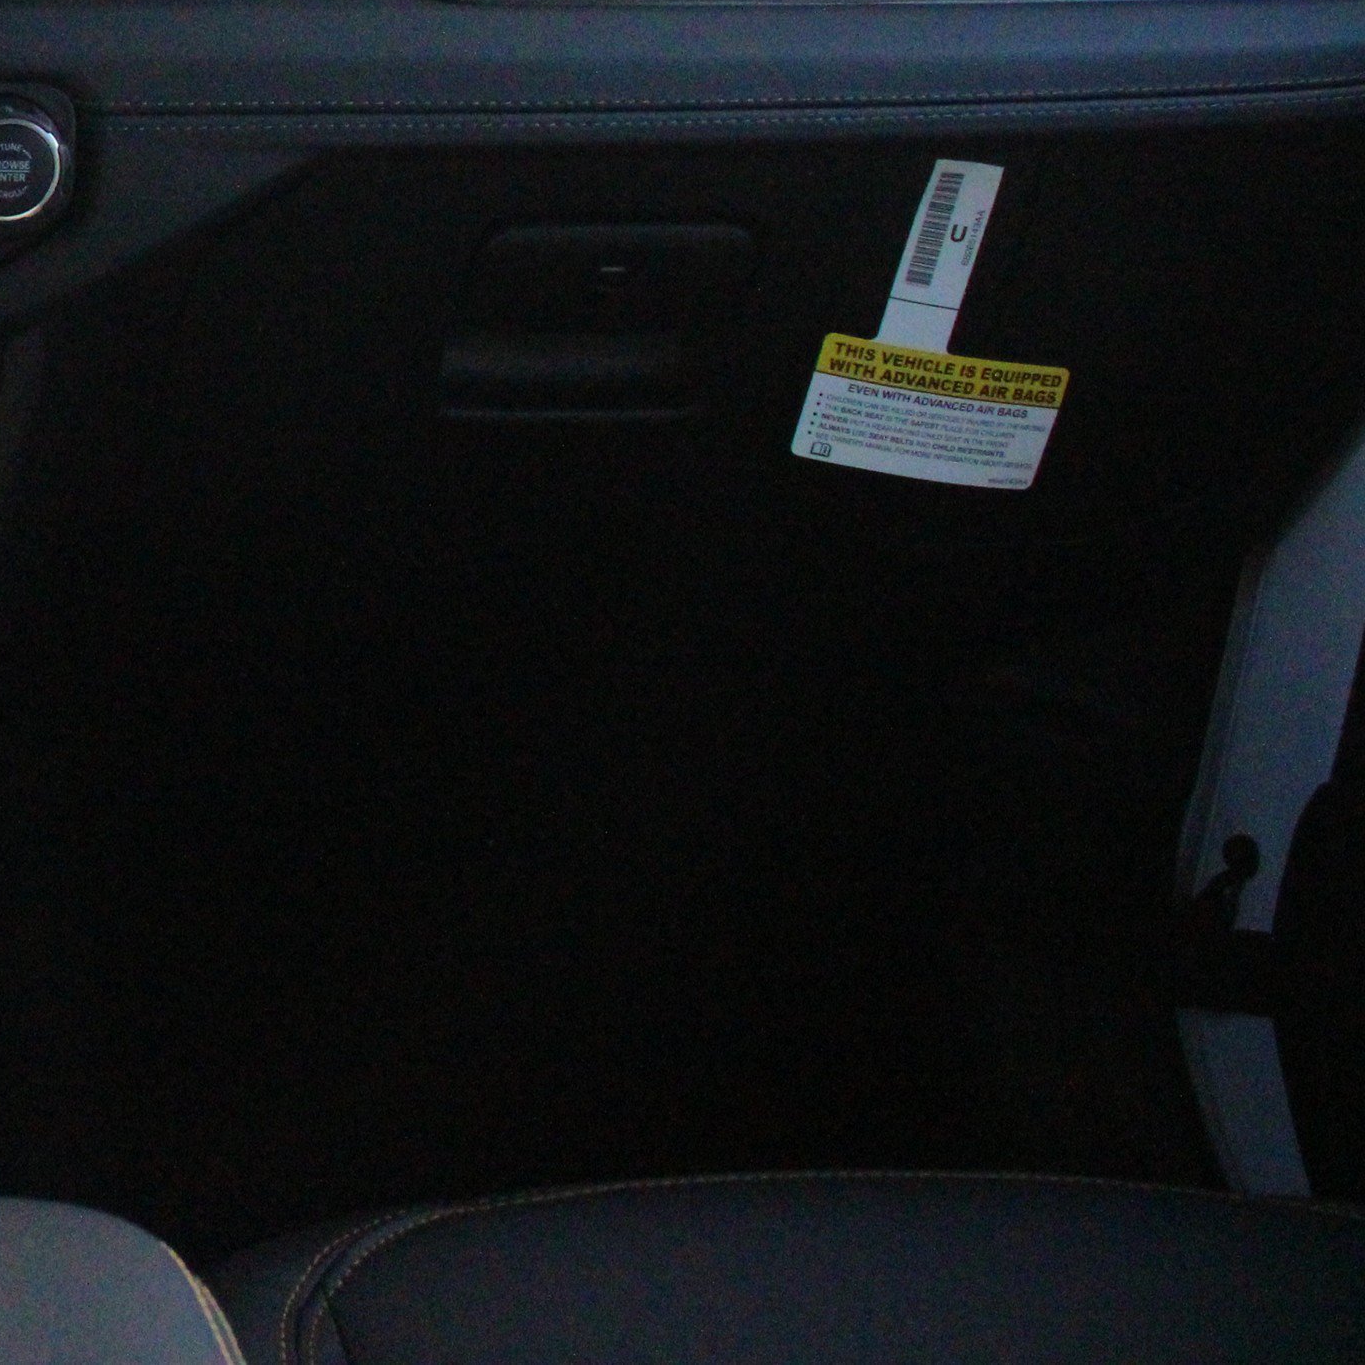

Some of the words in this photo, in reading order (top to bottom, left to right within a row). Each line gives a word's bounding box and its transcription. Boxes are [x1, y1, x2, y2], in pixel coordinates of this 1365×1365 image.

[0, 143, 24, 153] TUNE
[950, 225, 968, 243] U
[827, 358, 877, 378] WITH
[878, 368, 975, 395] ADVANCED
[978, 383, 1009, 400] AIR
[1011, 386, 1058, 406] BAGS
[831, 341, 878, 361] THIS
[878, 350, 957, 375] VEHICLE
[958, 364, 978, 379] IS
[979, 365, 1063, 391] EQUIPPED
[846, 383, 880, 398] EVEN
[880, 389, 912, 403] WITH
[912, 394, 975, 413] ADVANCED
[975, 404, 996, 415] AIR
[996, 406, 1029, 419] BAGS
